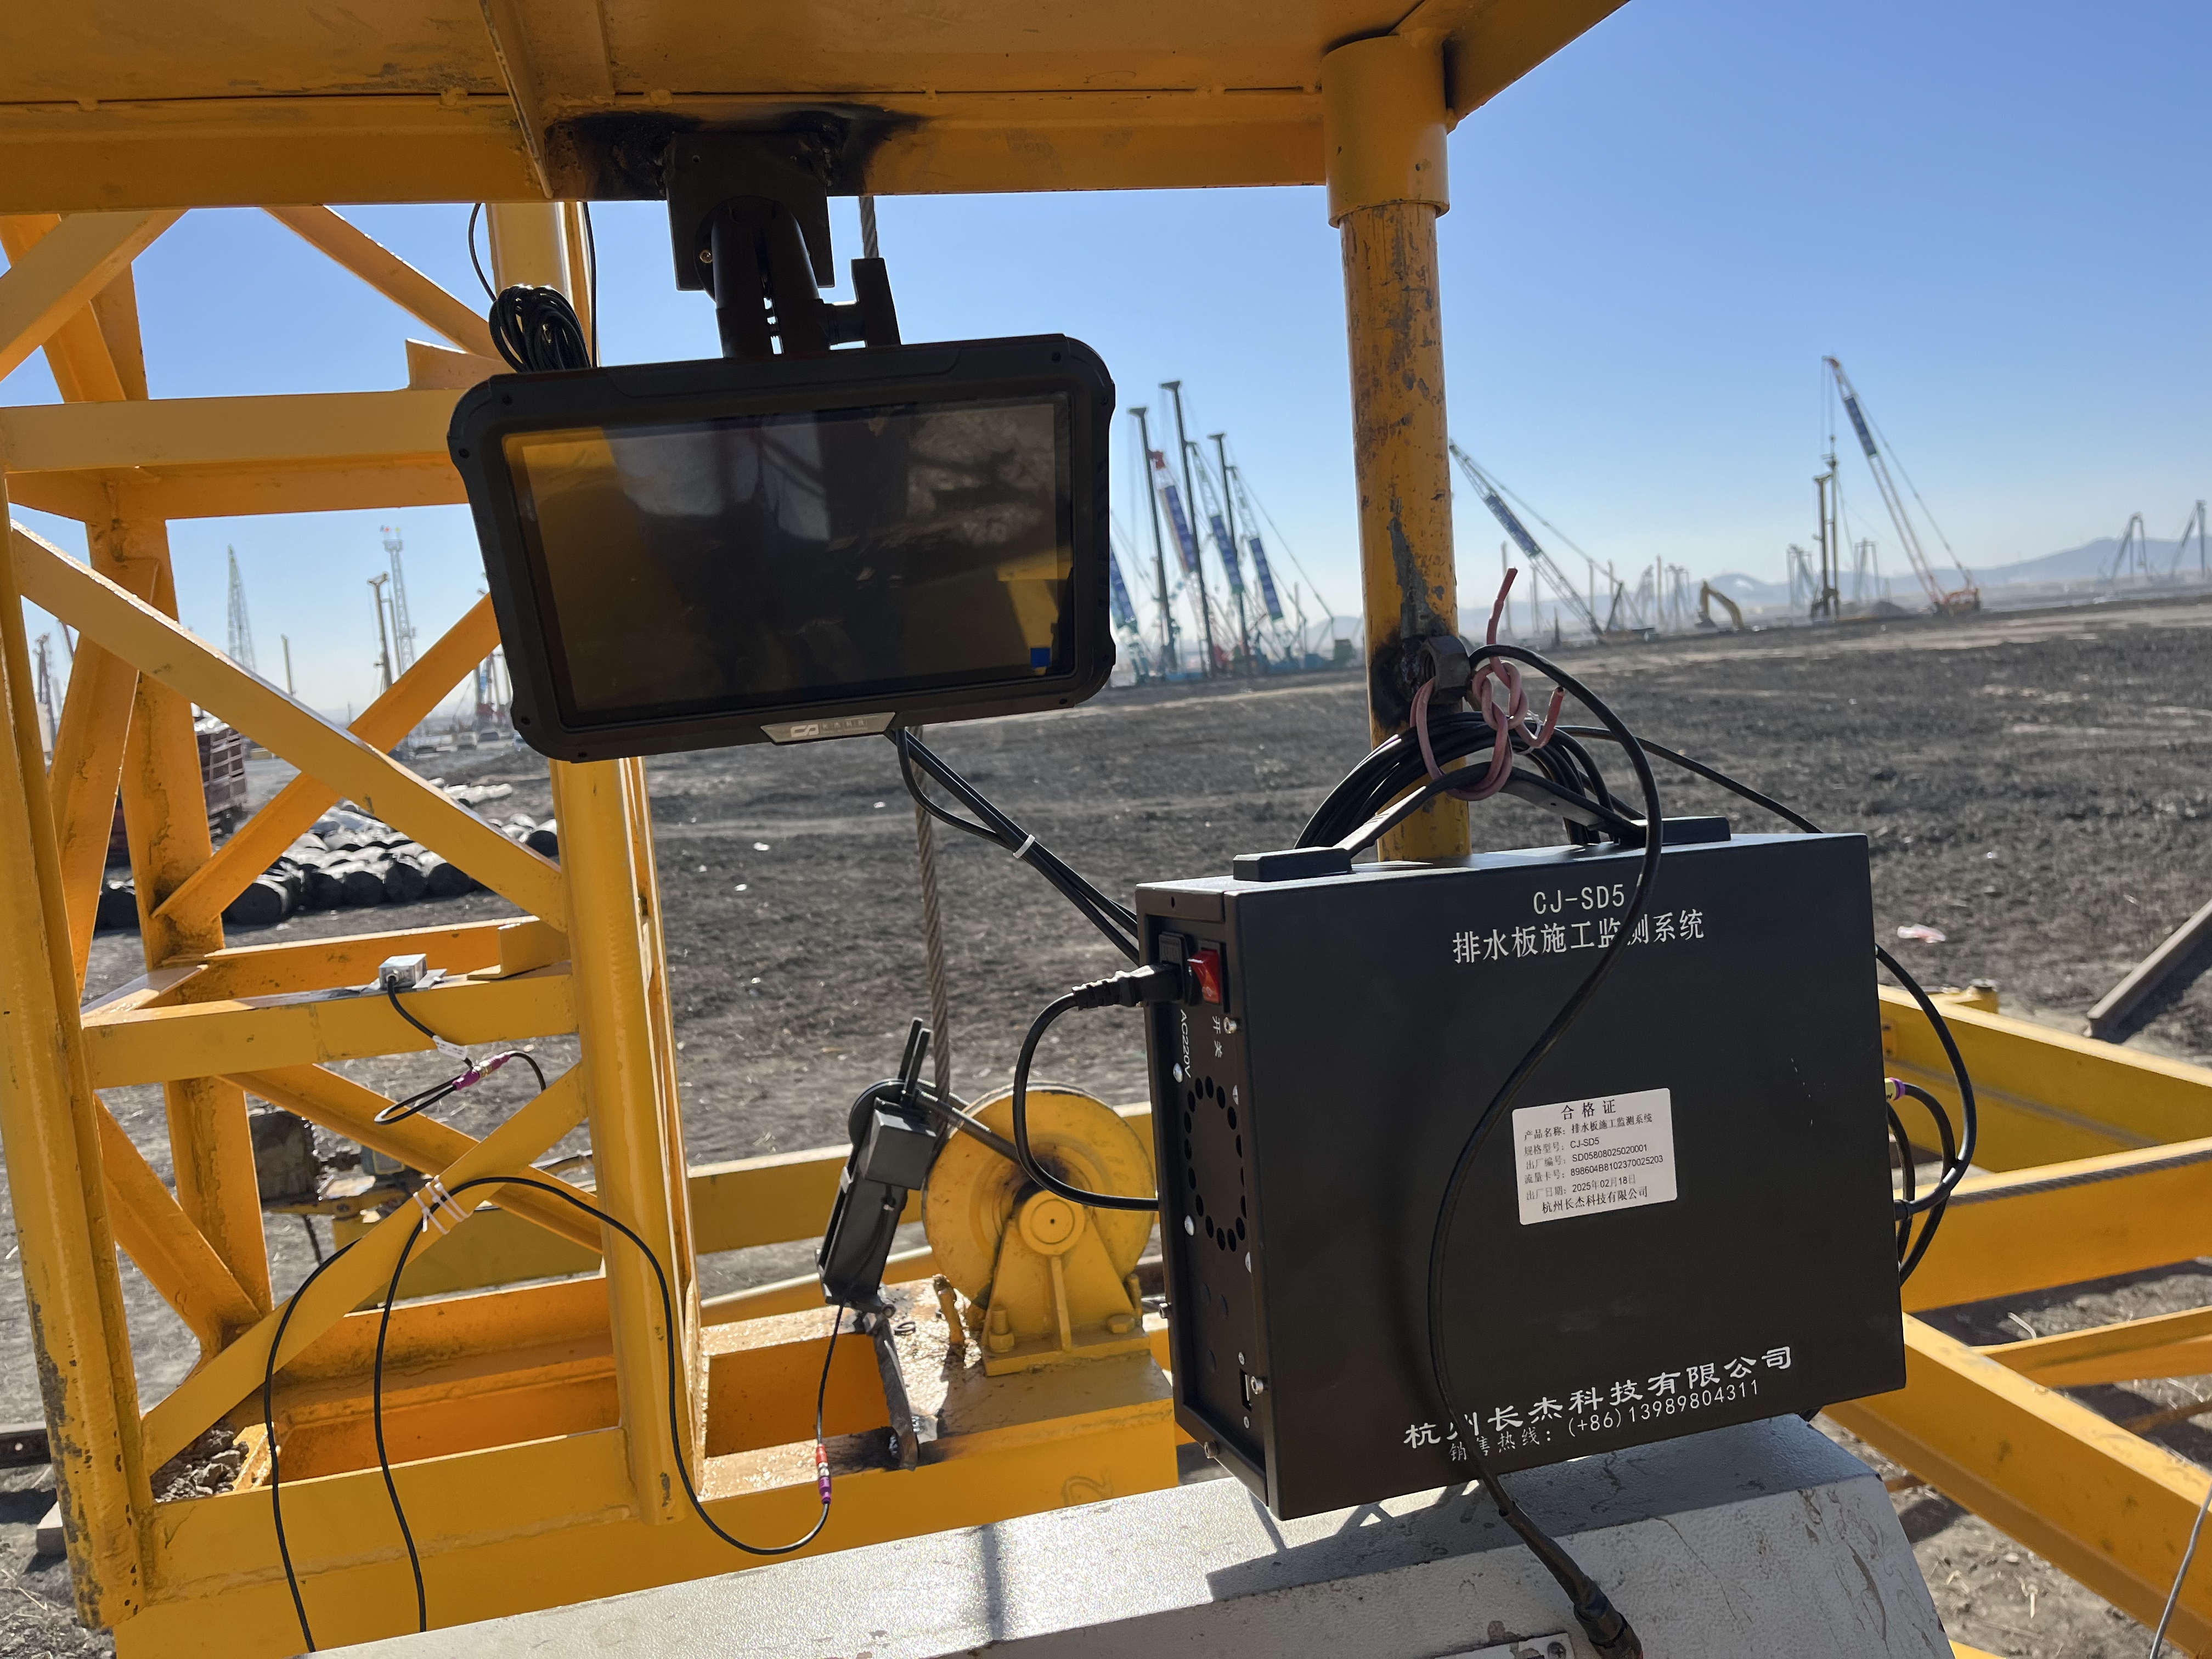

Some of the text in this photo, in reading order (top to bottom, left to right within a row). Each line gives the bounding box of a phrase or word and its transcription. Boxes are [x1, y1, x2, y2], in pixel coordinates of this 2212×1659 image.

[1533, 884, 1625, 915] CJ-SD5
[1181, 1009, 1191, 1079] AC220V
[1561, 1099, 1616, 1120] 合格证
[1570, 1137, 1600, 1149] CJ-SD5
[1572, 1144, 1647, 1162] SD05808025020001
[1572, 1173, 1636, 1193] 2025年02月18日
[1542, 1186, 1648, 1214] 杭州长杰科技有限公司
[1568, 1379, 1759, 1437] (+86)13989804311
